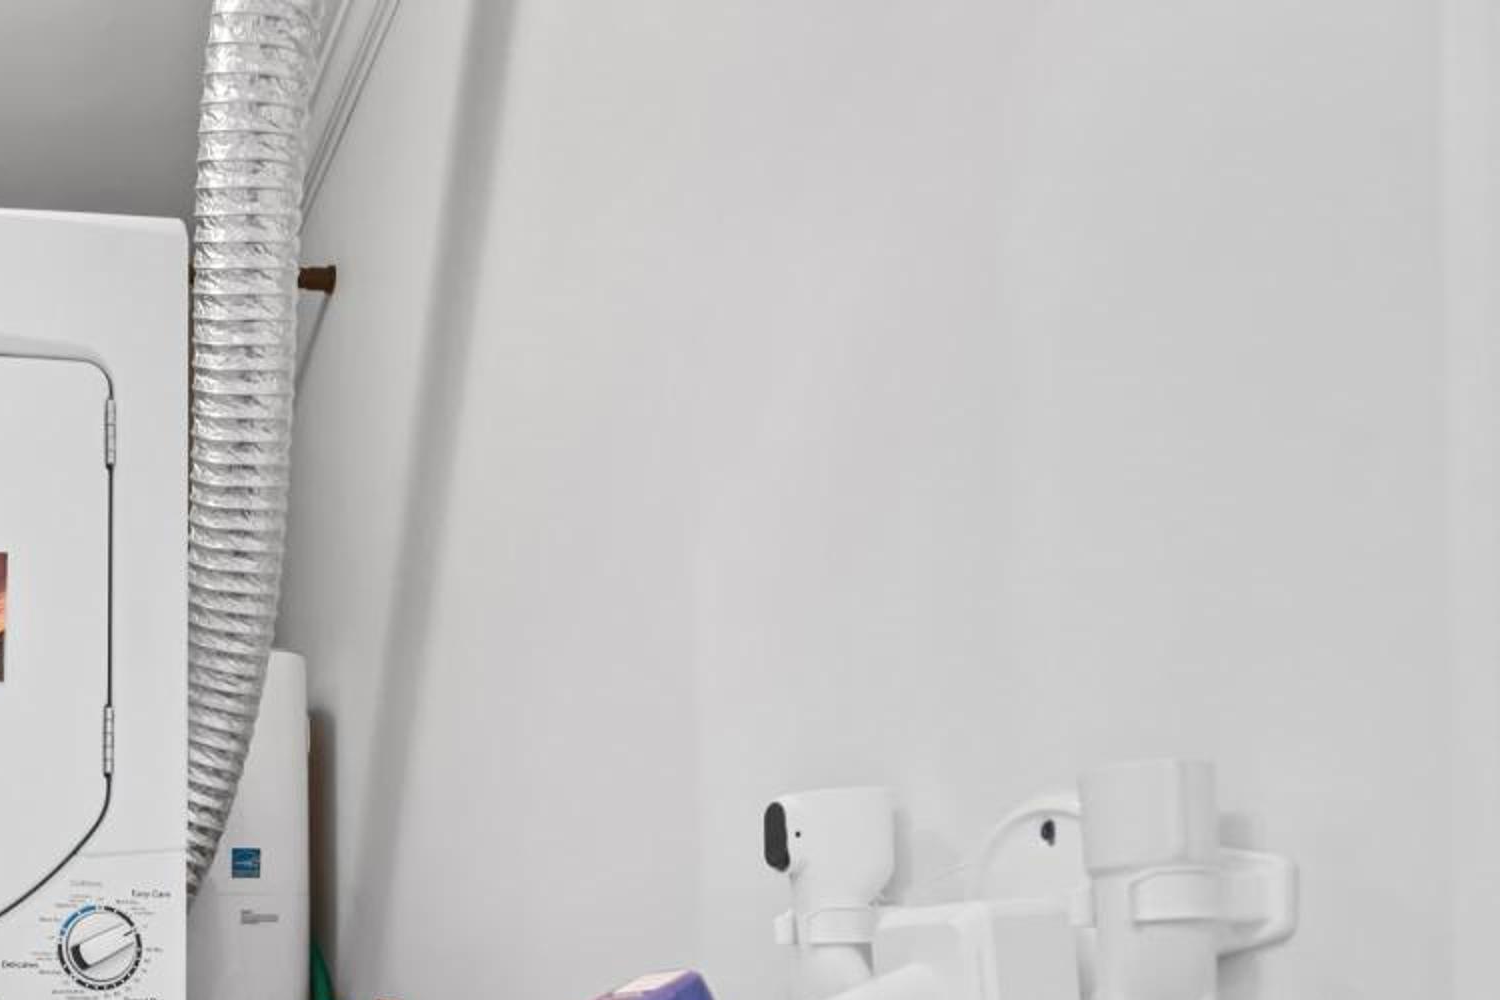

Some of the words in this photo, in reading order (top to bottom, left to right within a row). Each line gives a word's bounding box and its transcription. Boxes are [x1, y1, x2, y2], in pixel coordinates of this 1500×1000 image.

[131, 889, 150, 899] Easy
[152, 889, 171, 898] Care
[1, 959, 40, 969] Delicates
